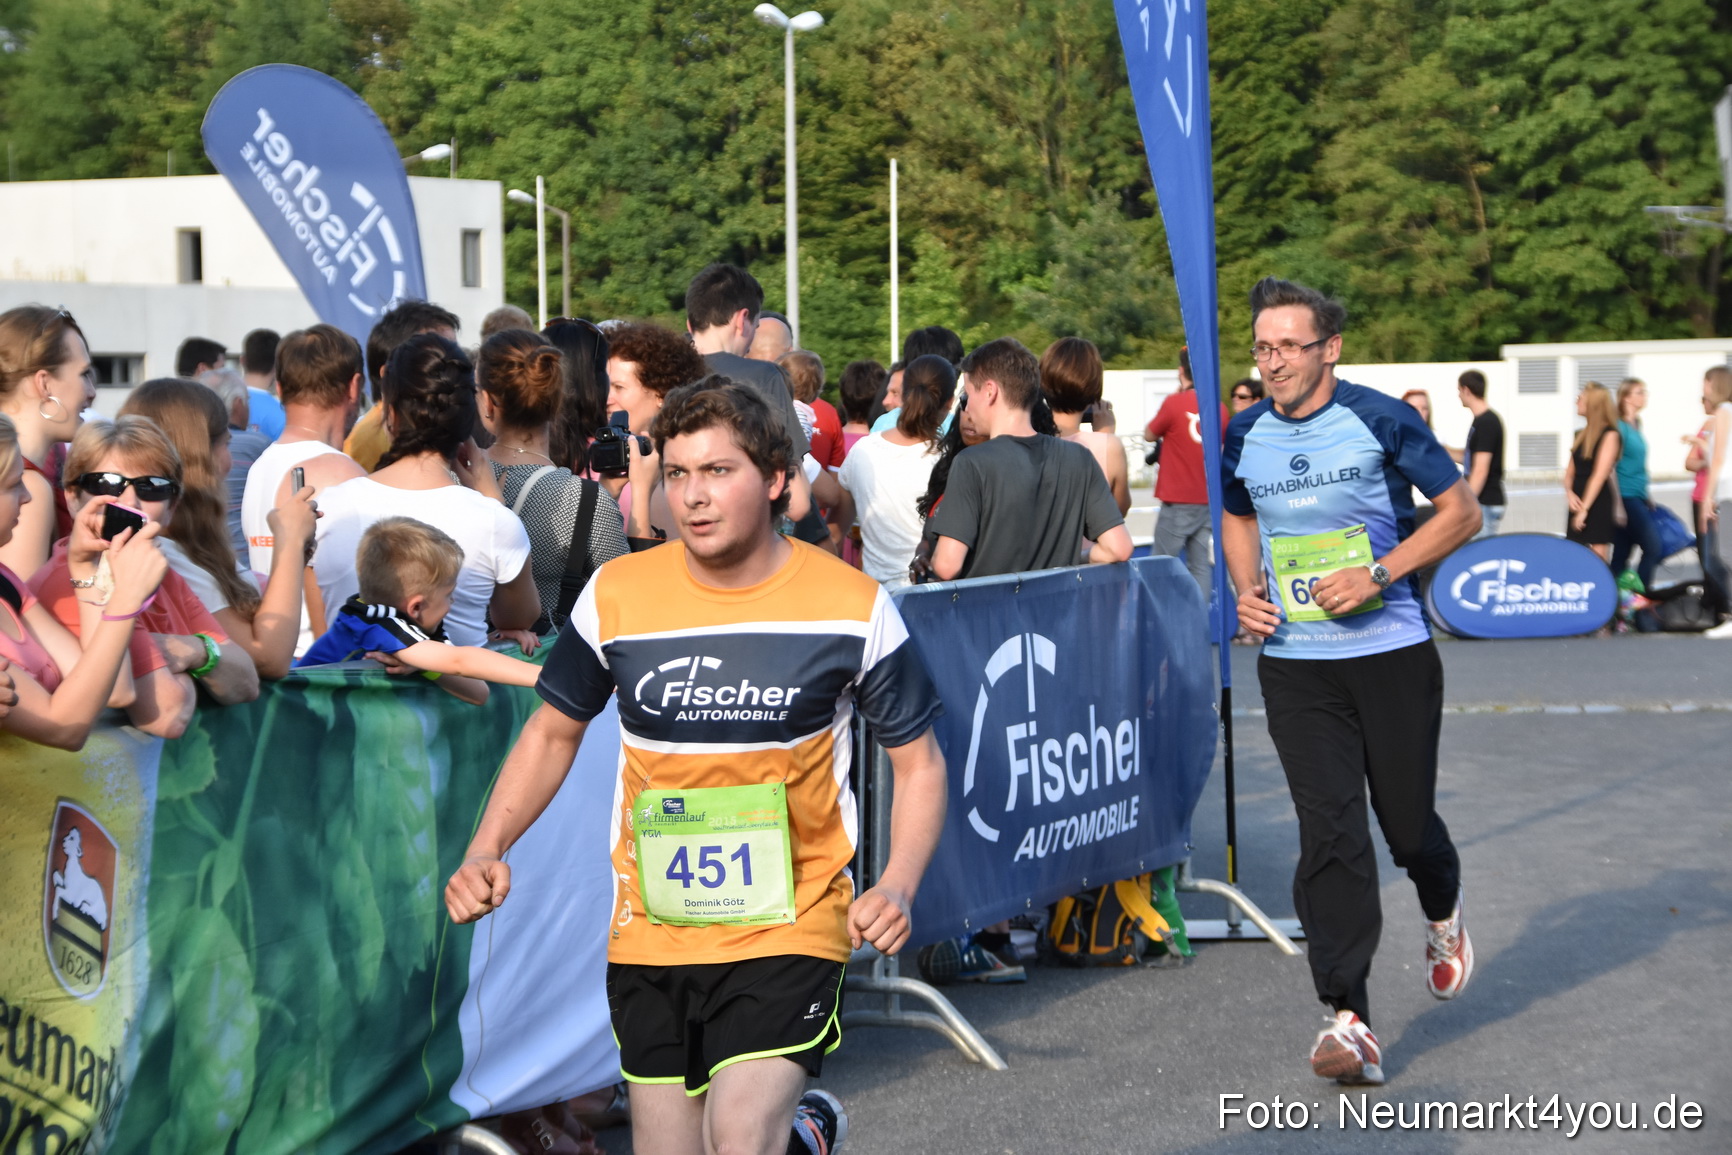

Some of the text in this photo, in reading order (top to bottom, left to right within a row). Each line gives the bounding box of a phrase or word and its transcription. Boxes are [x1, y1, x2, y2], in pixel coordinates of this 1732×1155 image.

[1250, 466, 1362, 500] SCHABMÜLLER
[1288, 495, 1319, 510] TEAM
[1478, 577, 1596, 605] Fischer
[1490, 601, 1590, 616] AUTOMOBILE
[1286, 622, 1403, 642] www.schabmueller.de
[661, 679, 801, 708] Fischer
[675, 709, 789, 722] AUTOMOBILE
[654, 811, 707, 823] firmenlauf
[1013, 795, 1140, 863] AUTOMOBILE
[665, 842, 753, 889] 451
[684, 898, 746, 908] Dominik Götz
[59, 946, 93, 986] 1628
